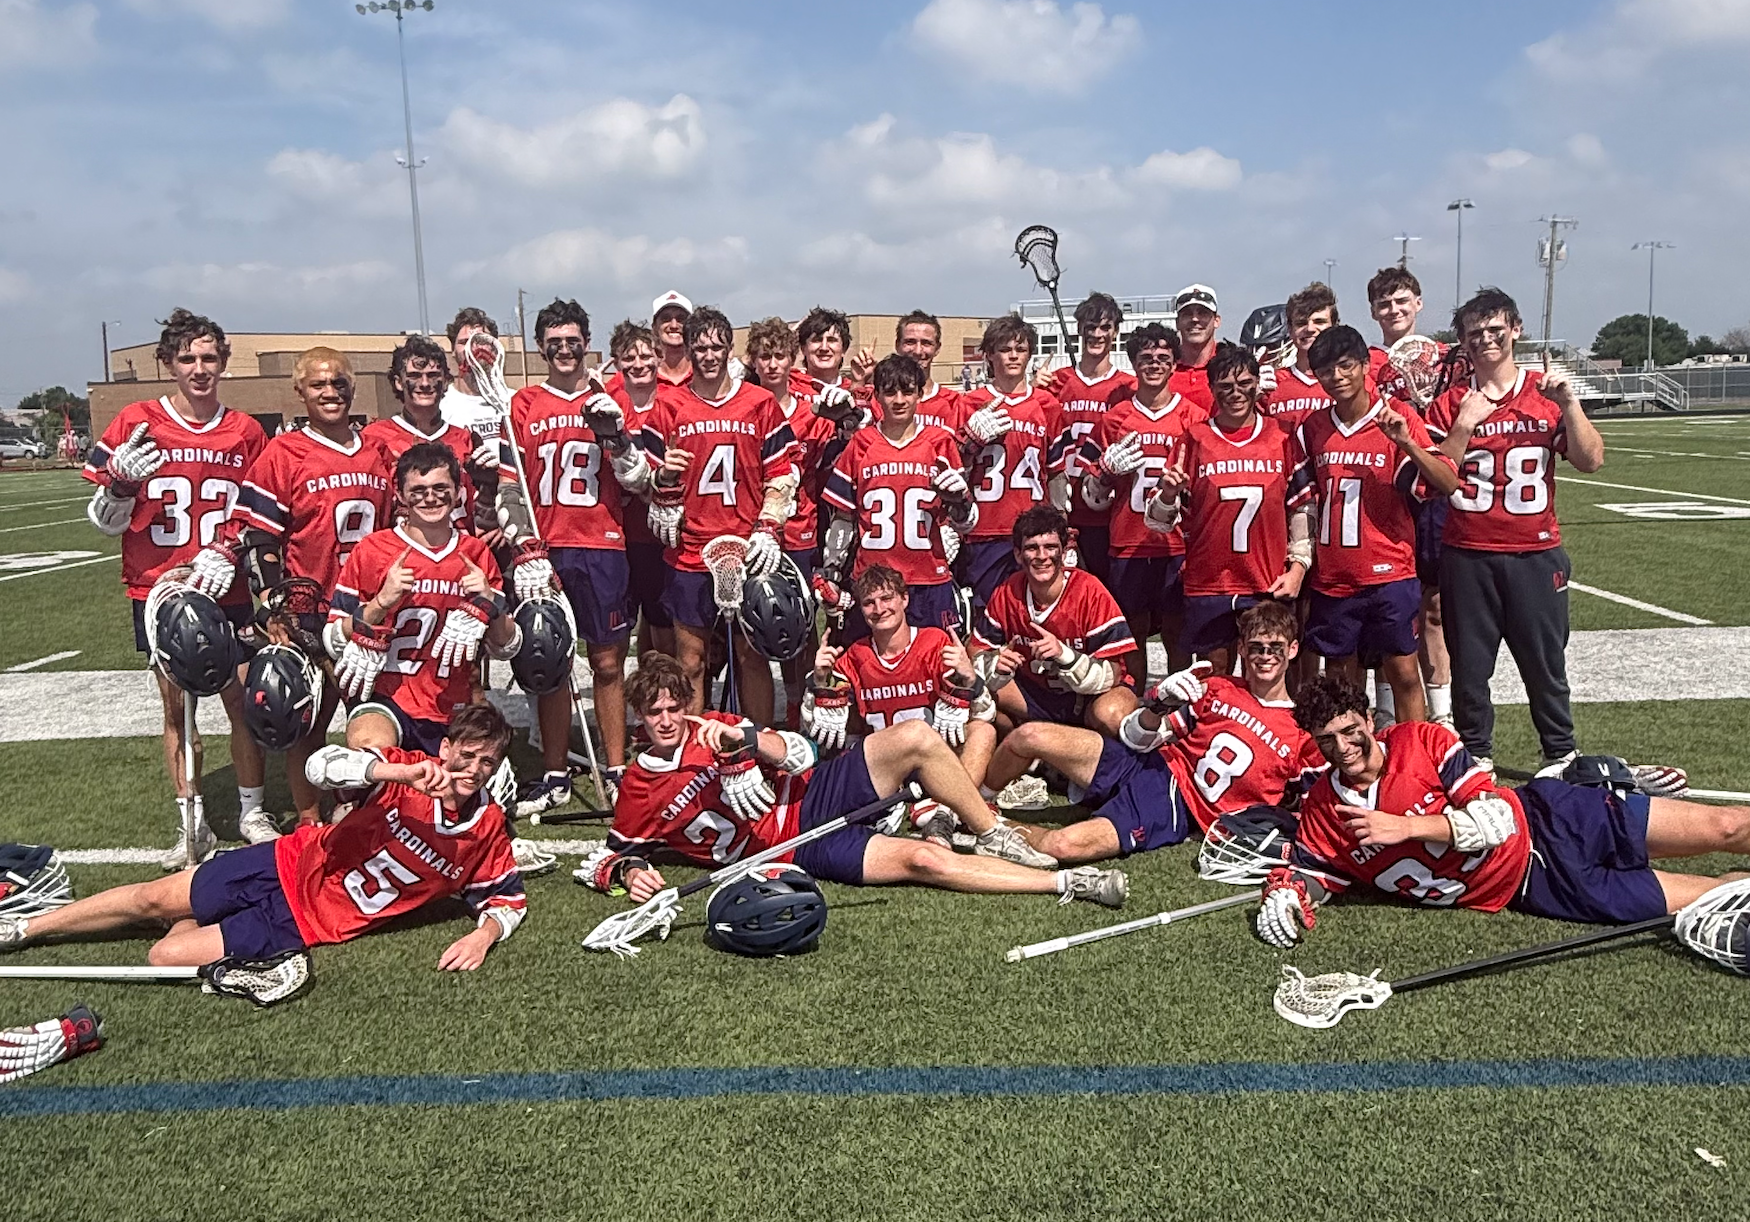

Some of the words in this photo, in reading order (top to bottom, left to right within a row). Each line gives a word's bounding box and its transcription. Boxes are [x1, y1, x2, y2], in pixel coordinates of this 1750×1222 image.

[530, 414, 589, 436] CARDIN
[678, 419, 756, 438] CARDINALS
[1060, 399, 1112, 414] ARDINA
[1269, 397, 1338, 415] CARDINA
[1475, 419, 1548, 438] RDINALS
[160, 448, 244, 468] ARDINALS
[306, 472, 388, 494] CARDINALS
[538, 440, 601, 507] 18
[698, 444, 738, 506] 4
[862, 462, 939, 479] CARDINALS
[973, 443, 1044, 501] 34
[1198, 459, 1284, 479] CARDINALS
[1449, 446, 1550, 514] 38
[147, 476, 240, 547] 32
[860, 487, 938, 550] 36
[1219, 486, 1264, 553] 7
[1320, 477, 1361, 547] 11
[411, 578, 467, 597] RDINAL
[383, 606, 451, 678] 2
[1210, 699, 1291, 759] CARDINALS
[660, 760, 719, 821] CARDINA
[1193, 732, 1254, 803] 8
[385, 807, 465, 880] CARDINALS
[683, 790, 750, 865] 2
[343, 849, 421, 915] 5
